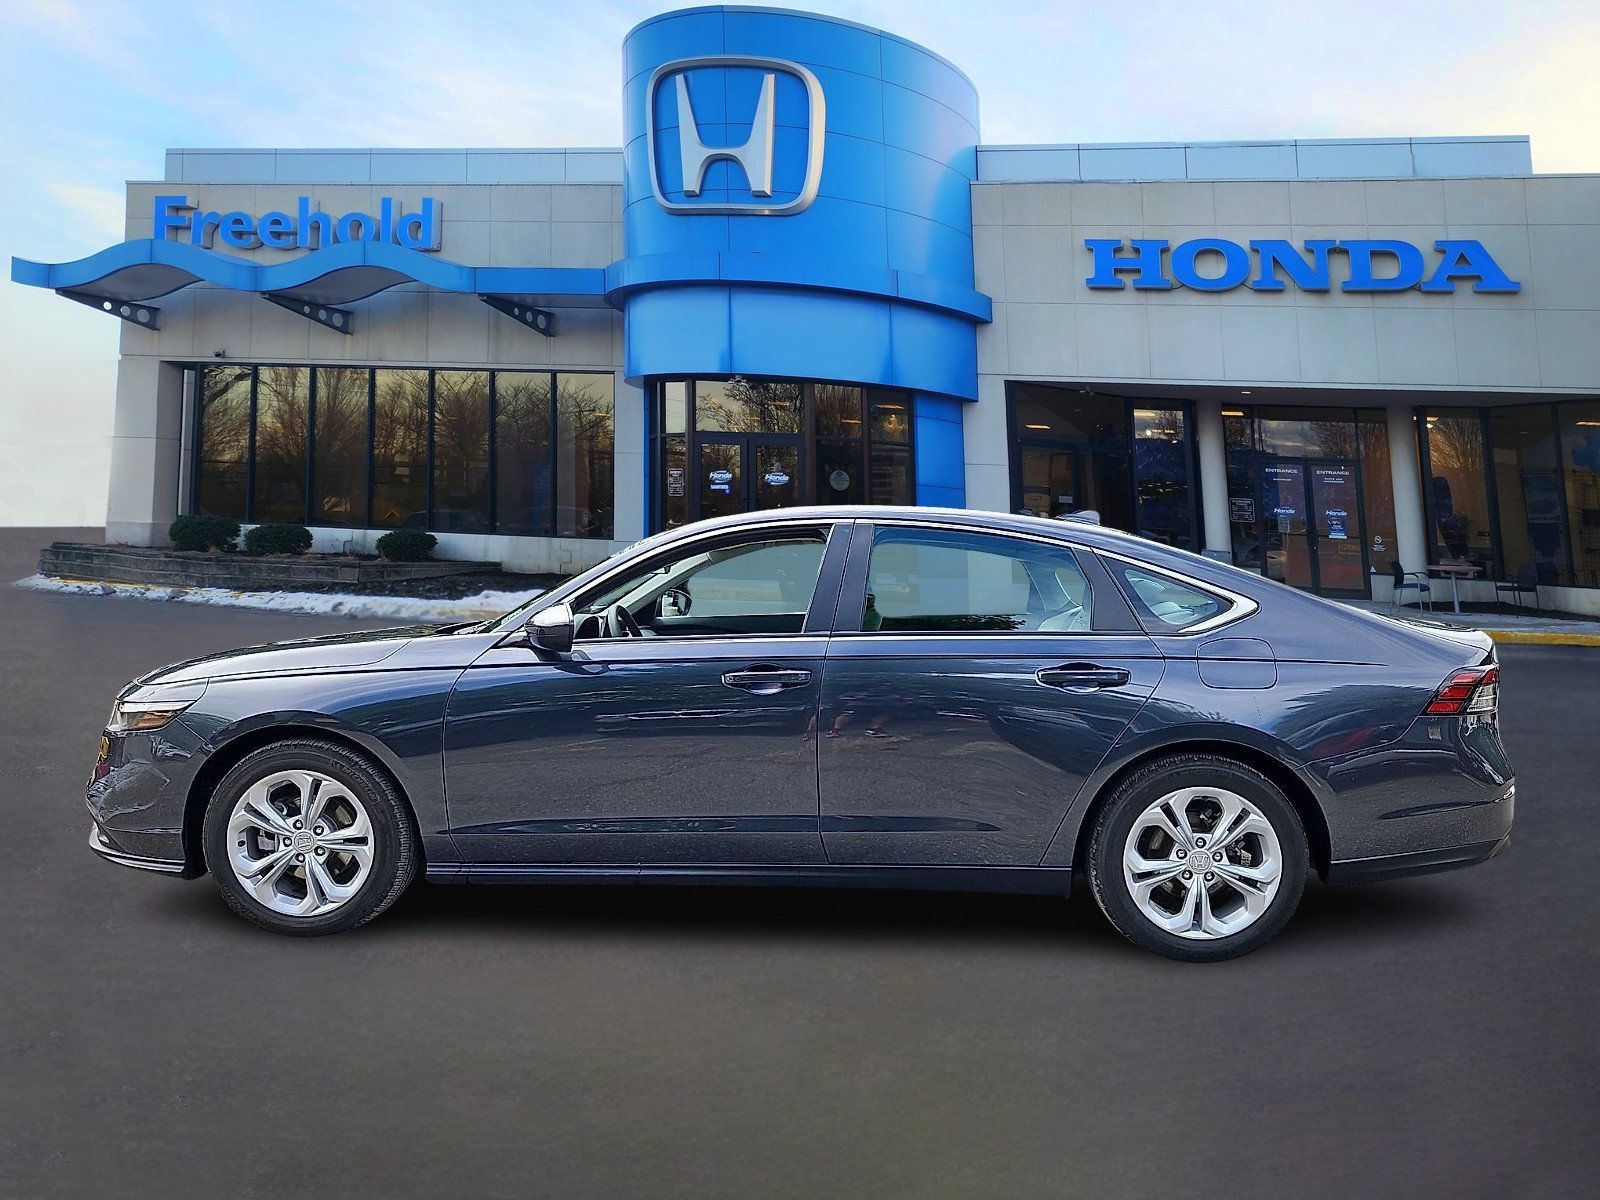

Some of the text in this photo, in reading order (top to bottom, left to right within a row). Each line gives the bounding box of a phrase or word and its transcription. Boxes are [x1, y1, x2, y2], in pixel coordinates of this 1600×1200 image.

[153, 195, 437, 250] Freehold
[1084, 238, 1522, 294] HONDA
[764, 473, 790, 481] Honda
